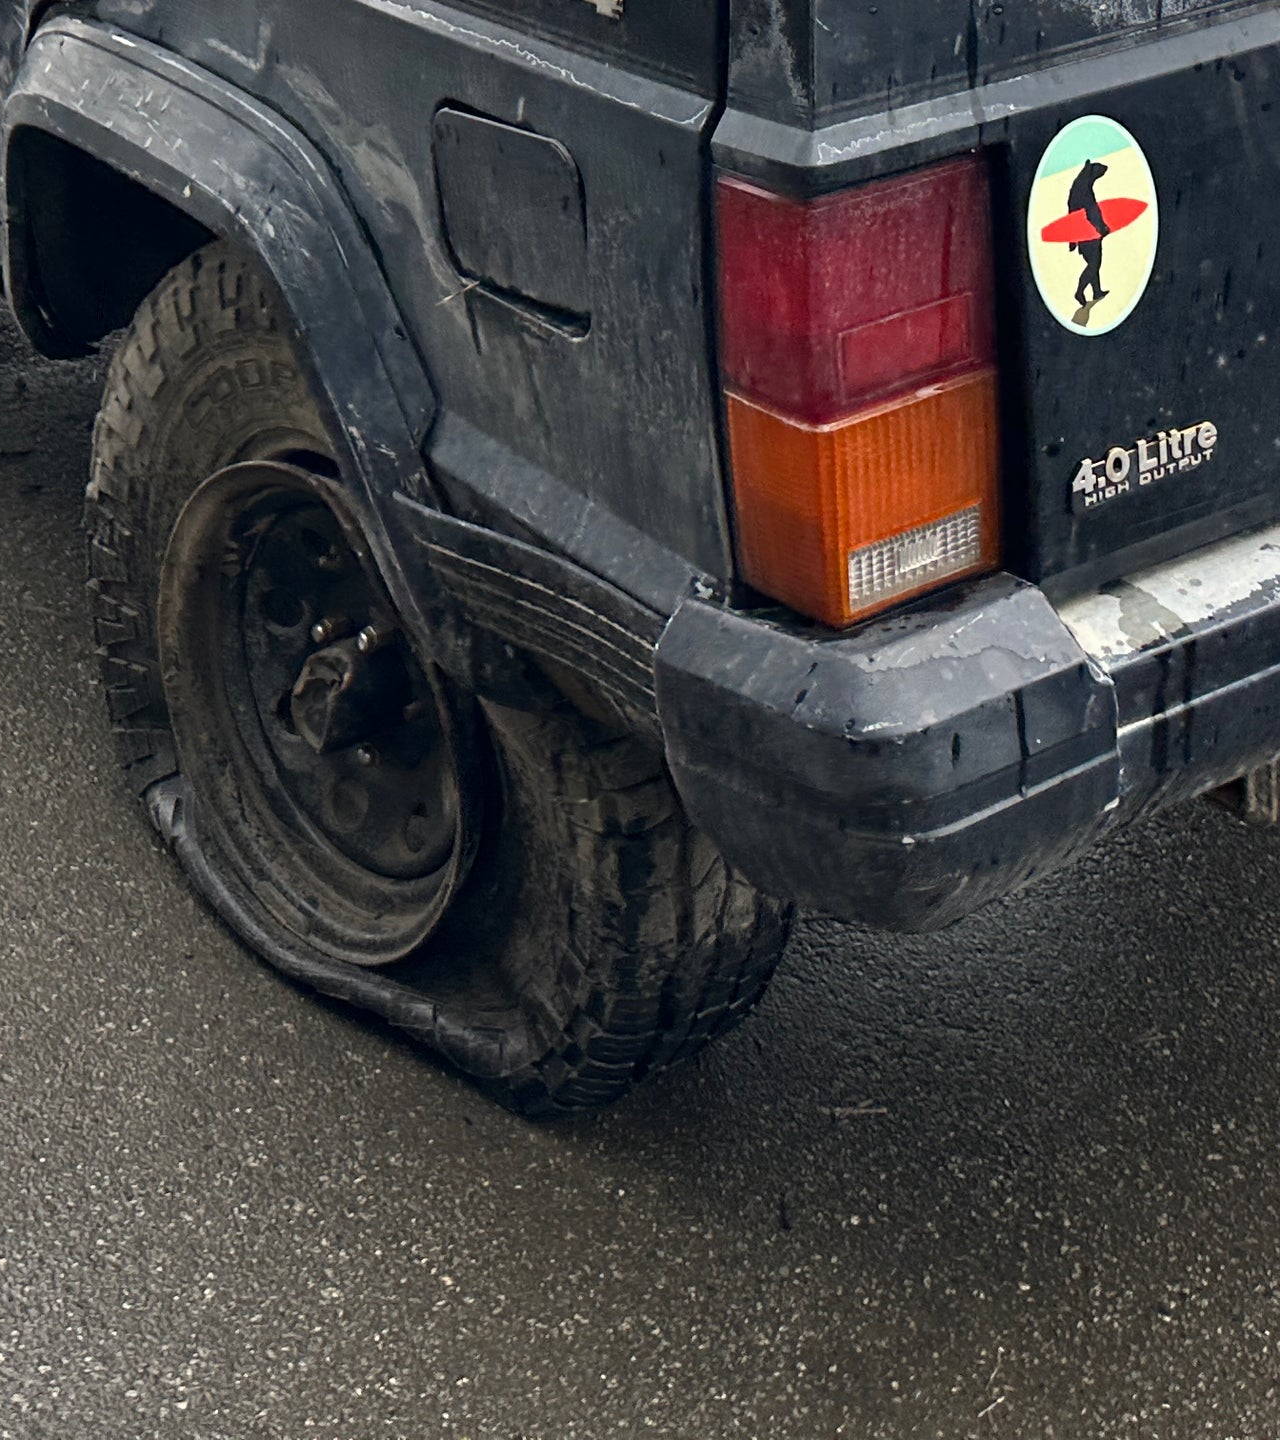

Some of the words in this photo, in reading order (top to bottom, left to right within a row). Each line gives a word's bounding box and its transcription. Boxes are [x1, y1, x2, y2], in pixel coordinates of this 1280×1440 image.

[1072, 446, 1131, 495] 4.0
[1136, 421, 1218, 473] Litre
[1085, 480, 1130, 507] HIGH
[1139, 449, 1213, 486] OUTPUT
